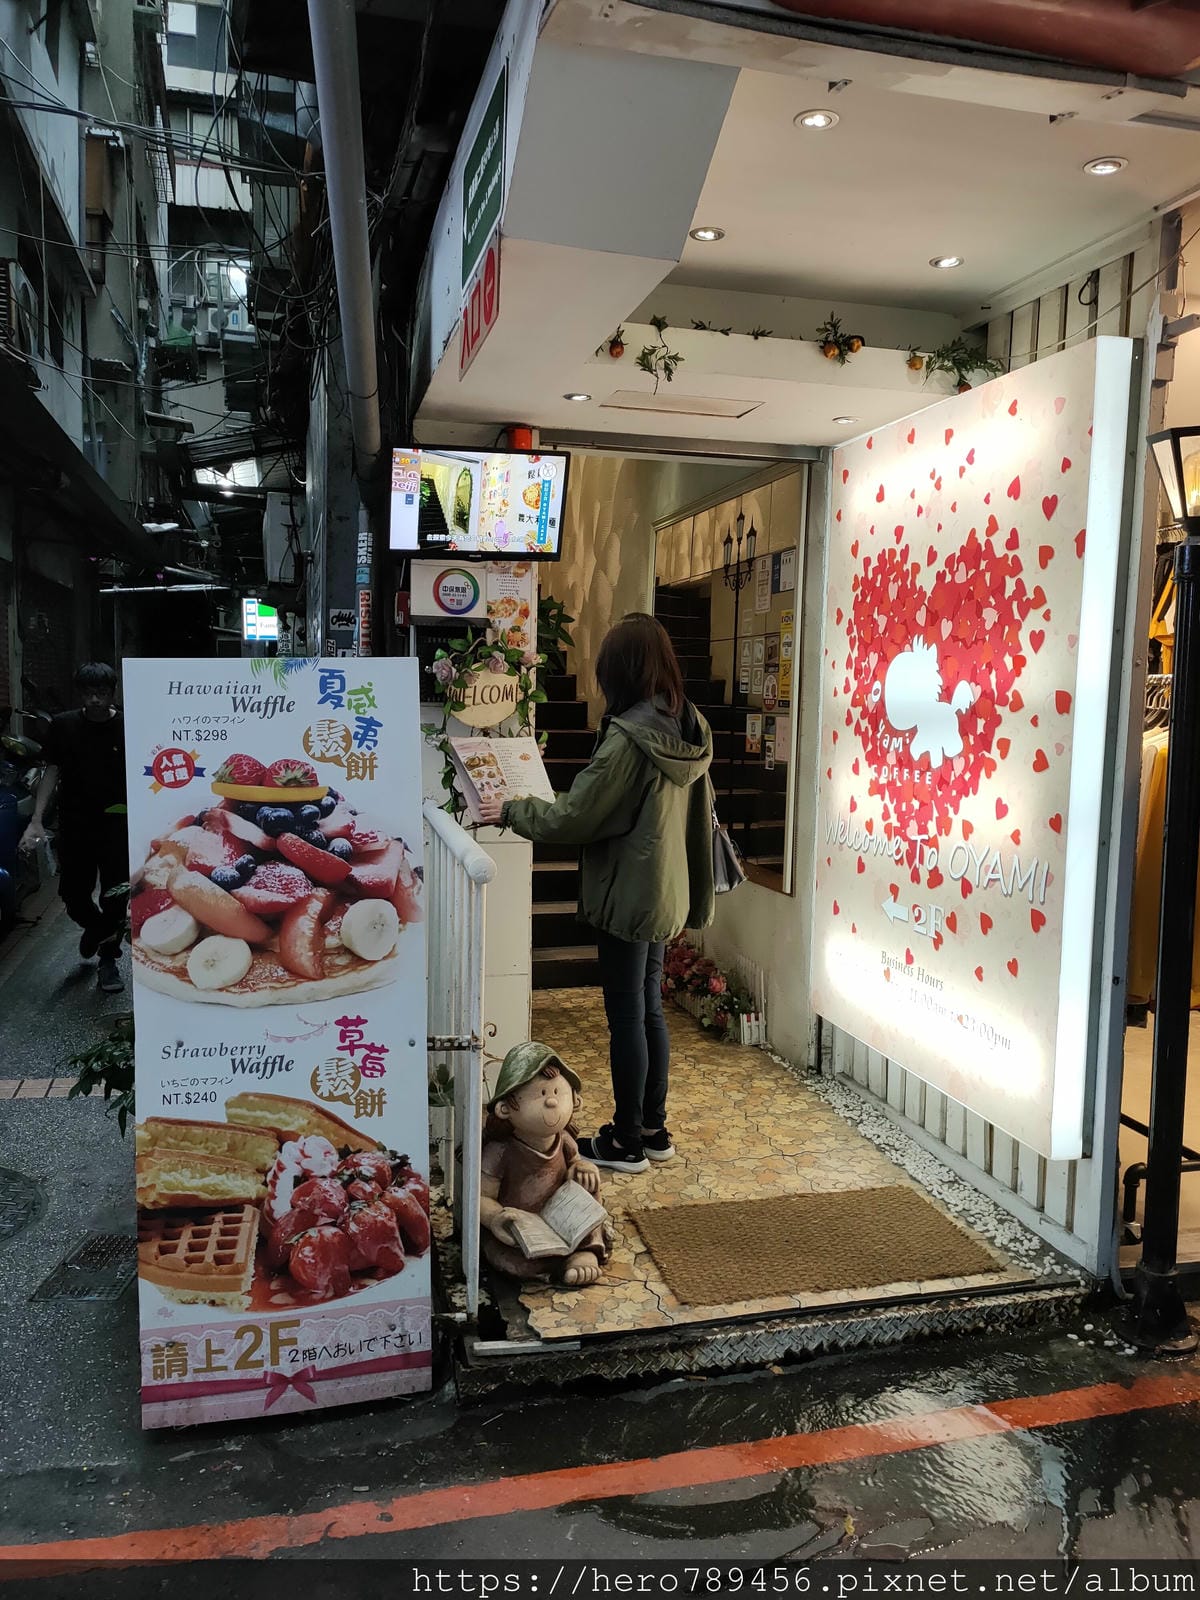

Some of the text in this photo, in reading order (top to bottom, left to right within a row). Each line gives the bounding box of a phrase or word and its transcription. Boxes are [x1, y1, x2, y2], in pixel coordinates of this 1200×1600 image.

[167, 680, 262, 696] Hawaiian
[231, 695, 296, 720] Waffle
[172, 715, 246, 725] ハワイのマフィン
[172, 729, 228, 742] NT.$298
[871, 764, 932, 785] COFFEE
[823, 811, 1050, 905] Welcome To OYAMI
[912, 903, 945, 940] 2F
[881, 950, 944, 991] Business Hours
[161, 1042, 266, 1060] Strawberry
[334, 1015, 389, 1079] 草莓
[230, 1055, 295, 1080] Waffle
[160, 1076, 234, 1088] いちごのマフィン
[162, 1090, 217, 1106] NT.$240
[288, 1331, 423, 1363] 2階へおいで下さい
